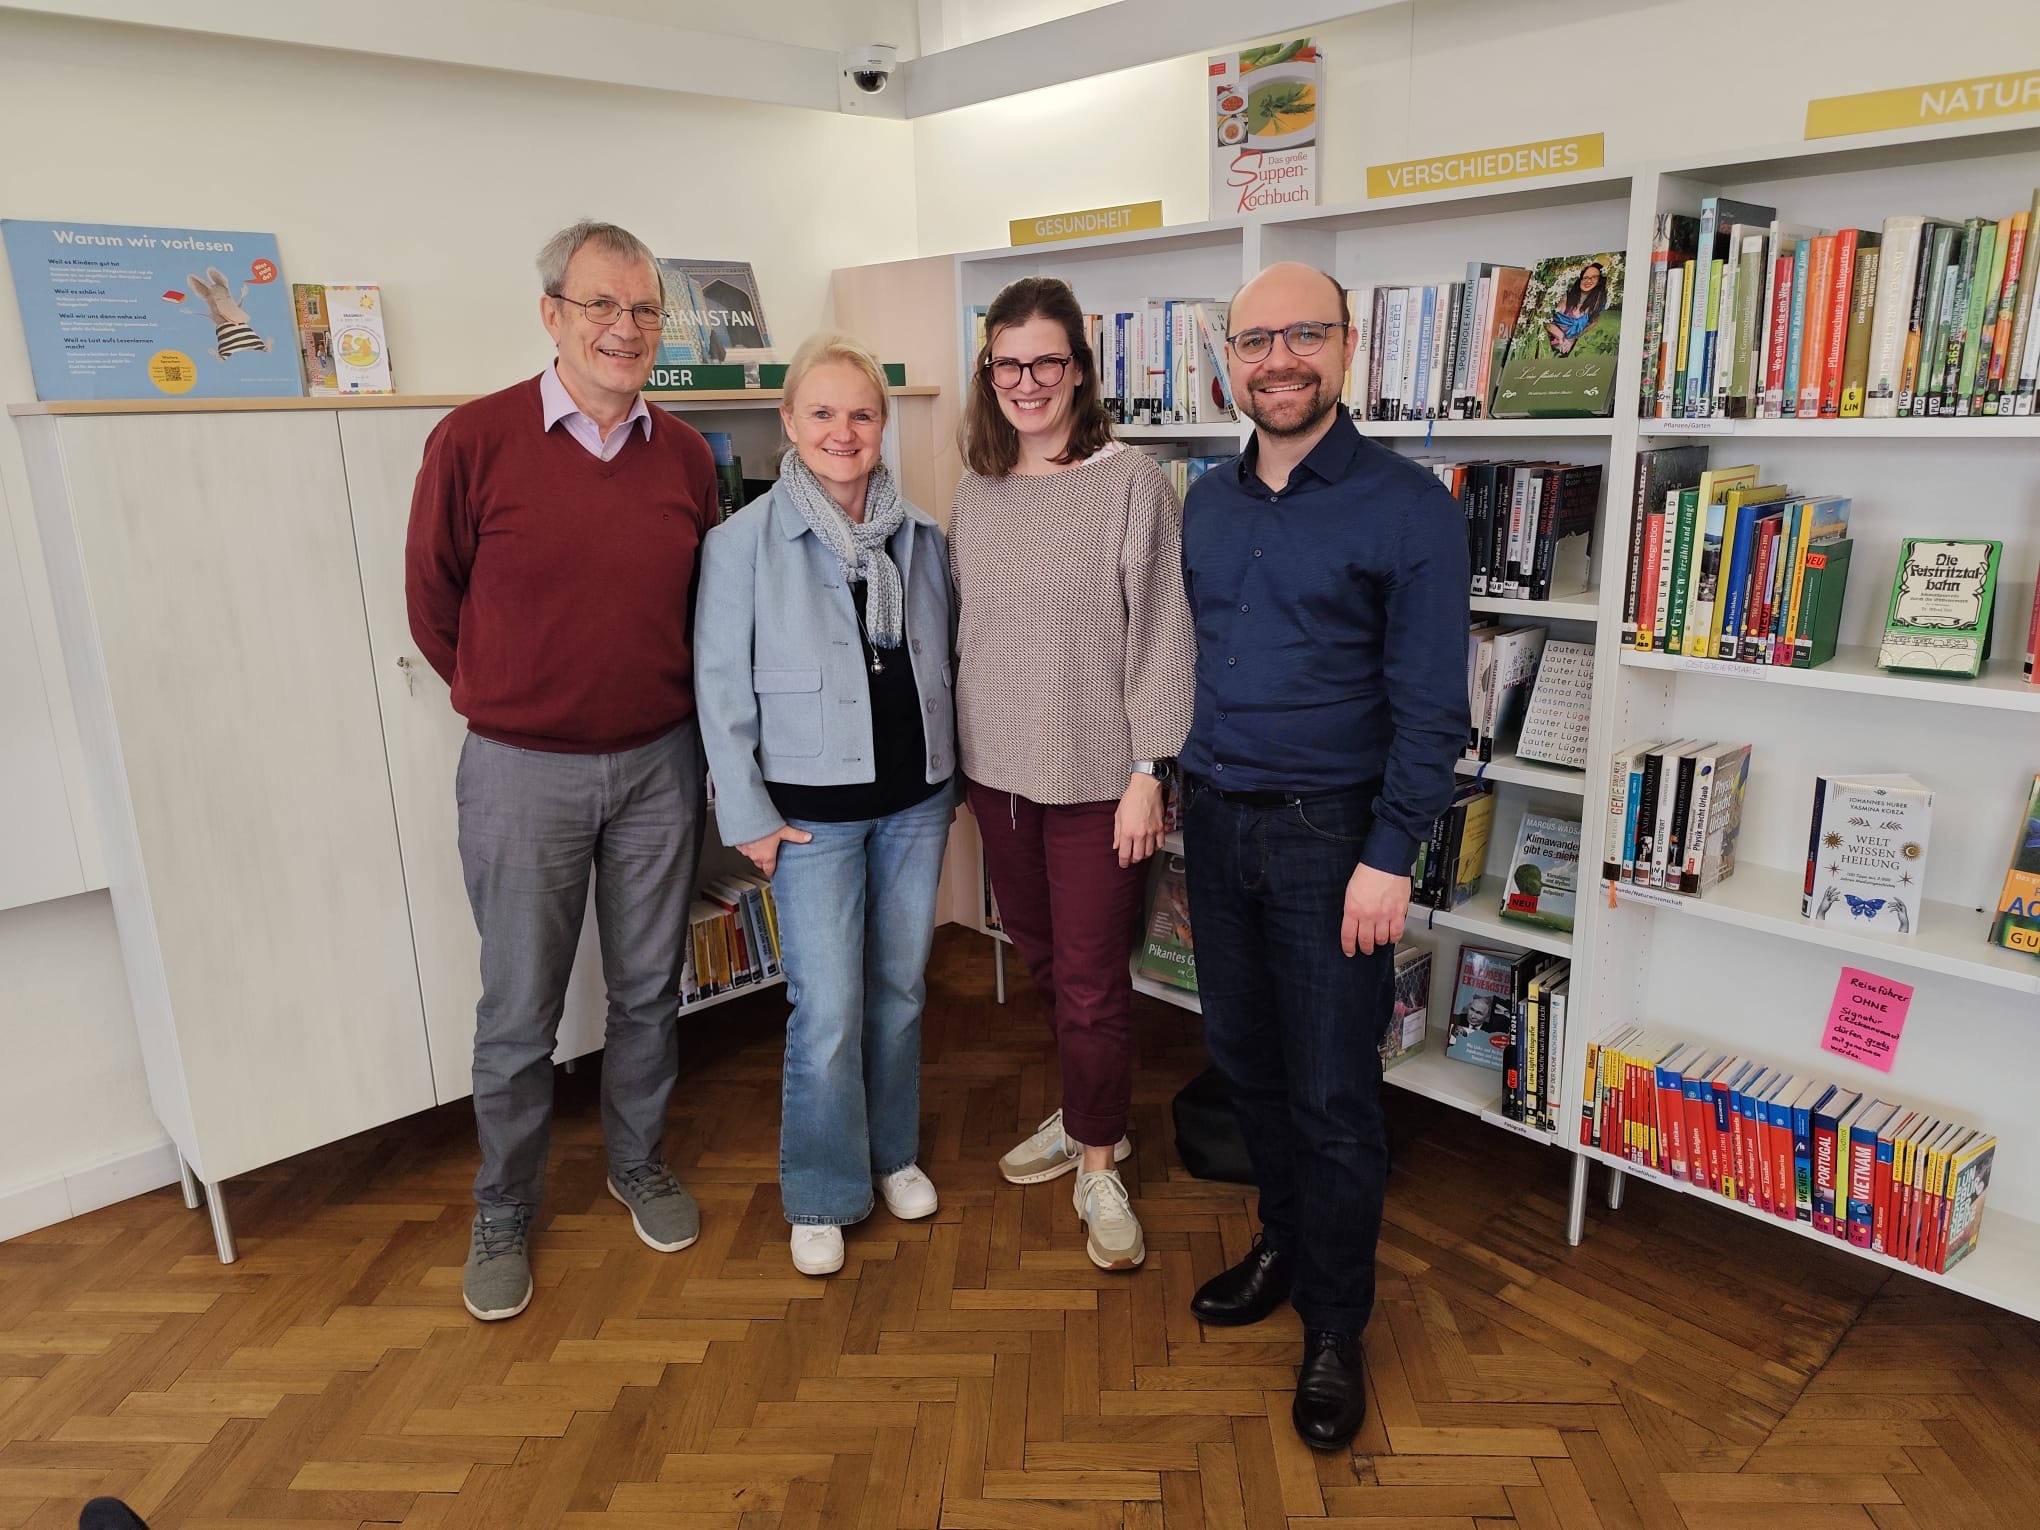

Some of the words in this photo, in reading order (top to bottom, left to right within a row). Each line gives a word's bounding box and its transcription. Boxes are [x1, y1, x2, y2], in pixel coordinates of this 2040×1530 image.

[1269, 156, 1284, 165] Das
[1285, 152, 1308, 164] große
[1387, 143, 1579, 190] VERSCHIEDENES
[1227, 149, 1308, 187] Suppen-
[1237, 183, 1309, 214] Kochbuch
[1034, 208, 1132, 238] GESUNDHEIT
[52, 230, 122, 247] Warum
[127, 235, 156, 248] wir
[161, 236, 234, 252] vorlesen
[1836, 246, 1850, 289] Biogarten
[1870, 254, 1879, 278] SÜDEN
[1778, 282, 1790, 299] Weg
[1861, 270, 1869, 295] WESTEN
[1695, 277, 1709, 328] Faszination
[1836, 291, 1844, 302] im
[1860, 296, 1868, 310] ALTE
[1777, 301, 1786, 312] ein
[1968, 296, 1982, 330] Garten
[1458, 322, 1470, 371] SPORTIDOLE
[1464, 279, 1475, 318] HAUTNAH
[1777, 314, 1785, 324] da
[1359, 318, 1368, 352] Demenz
[1390, 304, 1401, 361] PLACEBO
[1775, 325, 1784, 343] Wille
[1828, 305, 1842, 368] Pflanzenschutz
[1773, 346, 1782, 357] ein
[1772, 359, 1782, 371] Wo
[646, 370, 693, 386] NDER
[1844, 403, 1859, 412] LIN
[1930, 398, 1938, 413] PLO
[1637, 464, 1648, 520] ERZÄHLT
[1683, 504, 1694, 524] singt
[1634, 522, 1642, 554] NOCH
[1682, 526, 1692, 541] und
[1647, 521, 1658, 570] Integration
[1679, 544, 1689, 571] erzählt
[1807, 556, 1824, 566] NEU
[1936, 554, 1958, 566] Die
[1910, 565, 1983, 579] Feistritztal-
[1925, 579, 1960, 591] bahn
[1670, 578, 1686, 627] Gasen
[1548, 644, 1579, 655] Lauter
[1545, 654, 1576, 665] Lauter
[1581, 657, 1595, 668] Lüg
[1542, 665, 1574, 675] Lauter
[1578, 667, 1594, 679] Lüg
[1540, 675, 1571, 685] Lauter
[1575, 678, 1592, 690] Lüg
[1537, 685, 1571, 697] Konrad
[1575, 690, 1592, 700] Pau
[1535, 696, 1585, 709] Liessmann
[1529, 716, 1560, 728] Lauter
[1532, 706, 1563, 717] Lauter
[1567, 710, 1590, 722] Lüge
[1526, 727, 1558, 738] Lauter
[1523, 737, 1554, 748] Lauter
[1558, 743, 1587, 754] Lügen
[1520, 748, 1552, 759] Lauter
[1555, 753, 1585, 765] Lügen
[1610, 787, 1625, 815] GENE
[1698, 786, 1708, 808] Urlaub
[1850, 798, 1884, 806] JOHANNES
[1526, 819, 1555, 831] MARCUS
[1558, 824, 1580, 834] WADS
[1696, 809, 1705, 829] macht
[1692, 831, 1703, 851] Physik
[1856, 835, 1891, 847] WELT
[1523, 845, 1541, 855] gibt
[1543, 849, 1553, 857] es
[1848, 844, 1896, 858] WISSEN
[1842, 855, 1900, 870] HEILUNG
[1512, 898, 1535, 910] NEU!
[1148, 944, 1186, 964] Pikantes
[1851, 978, 1908, 1002] Reiseführer
[1852, 995, 1888, 1013] OHNE
[1840, 1007, 1883, 1025] Signatur
[1511, 1034, 1517, 1045] EM
[1834, 1025, 1862, 1040] dürfen
[1865, 1037, 1890, 1052] gratis
[1504, 1121, 1527, 1134] Fotografie
[1693, 1128, 1701, 1155] Belgien
[1817, 1136, 1831, 1187] PORTUGAL
[1852, 1146, 1872, 1200] VIETNAM
[1798, 1166, 1808, 1202] WENIEN
